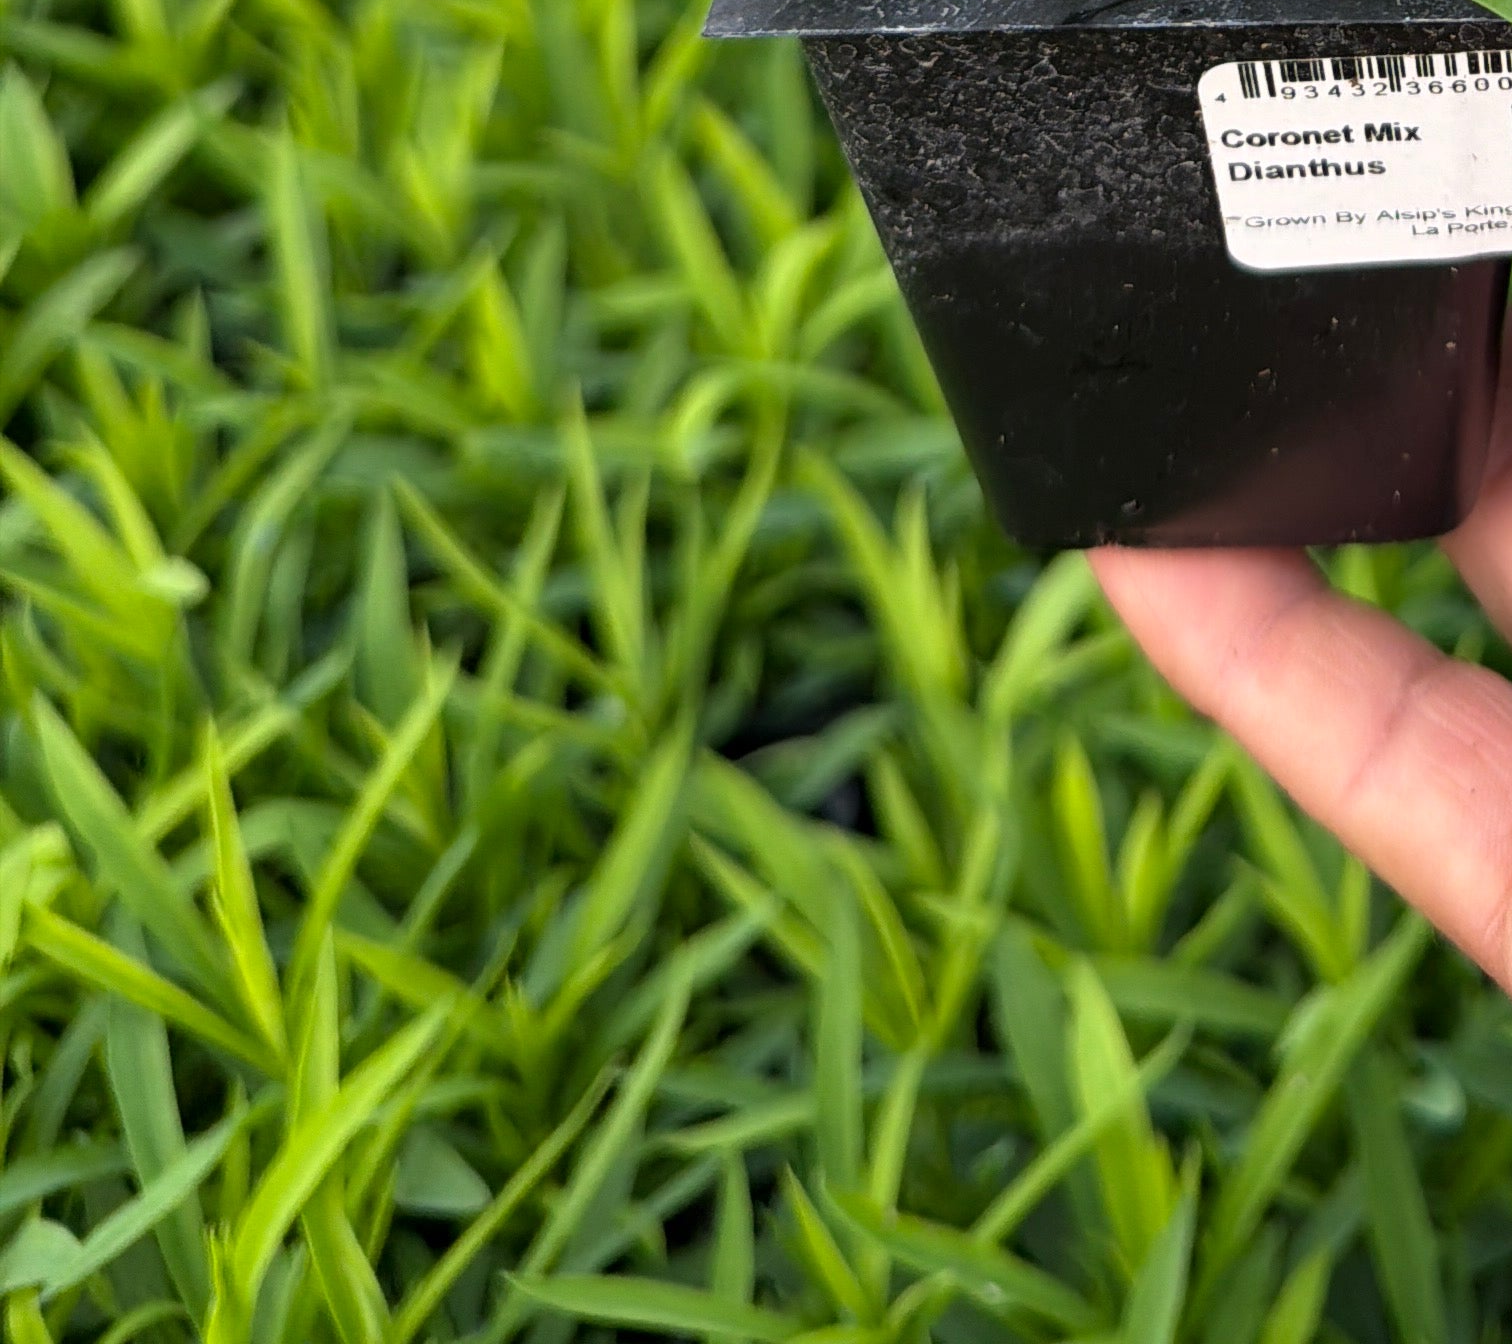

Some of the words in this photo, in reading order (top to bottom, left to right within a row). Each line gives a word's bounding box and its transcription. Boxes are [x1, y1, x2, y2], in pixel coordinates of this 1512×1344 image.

[1214, 92, 1227, 103] 4
[1280, 81, 1387, 100] 93432
[1406, 76, 1512, 97] 36600
[1220, 124, 1355, 148] Coronet
[1364, 122, 1422, 143] Mix
[1228, 158, 1386, 182] Dianthus
[1336, 210, 1366, 225] By
[1376, 207, 1457, 223] Alsip's
[1412, 224, 1440, 236] La
